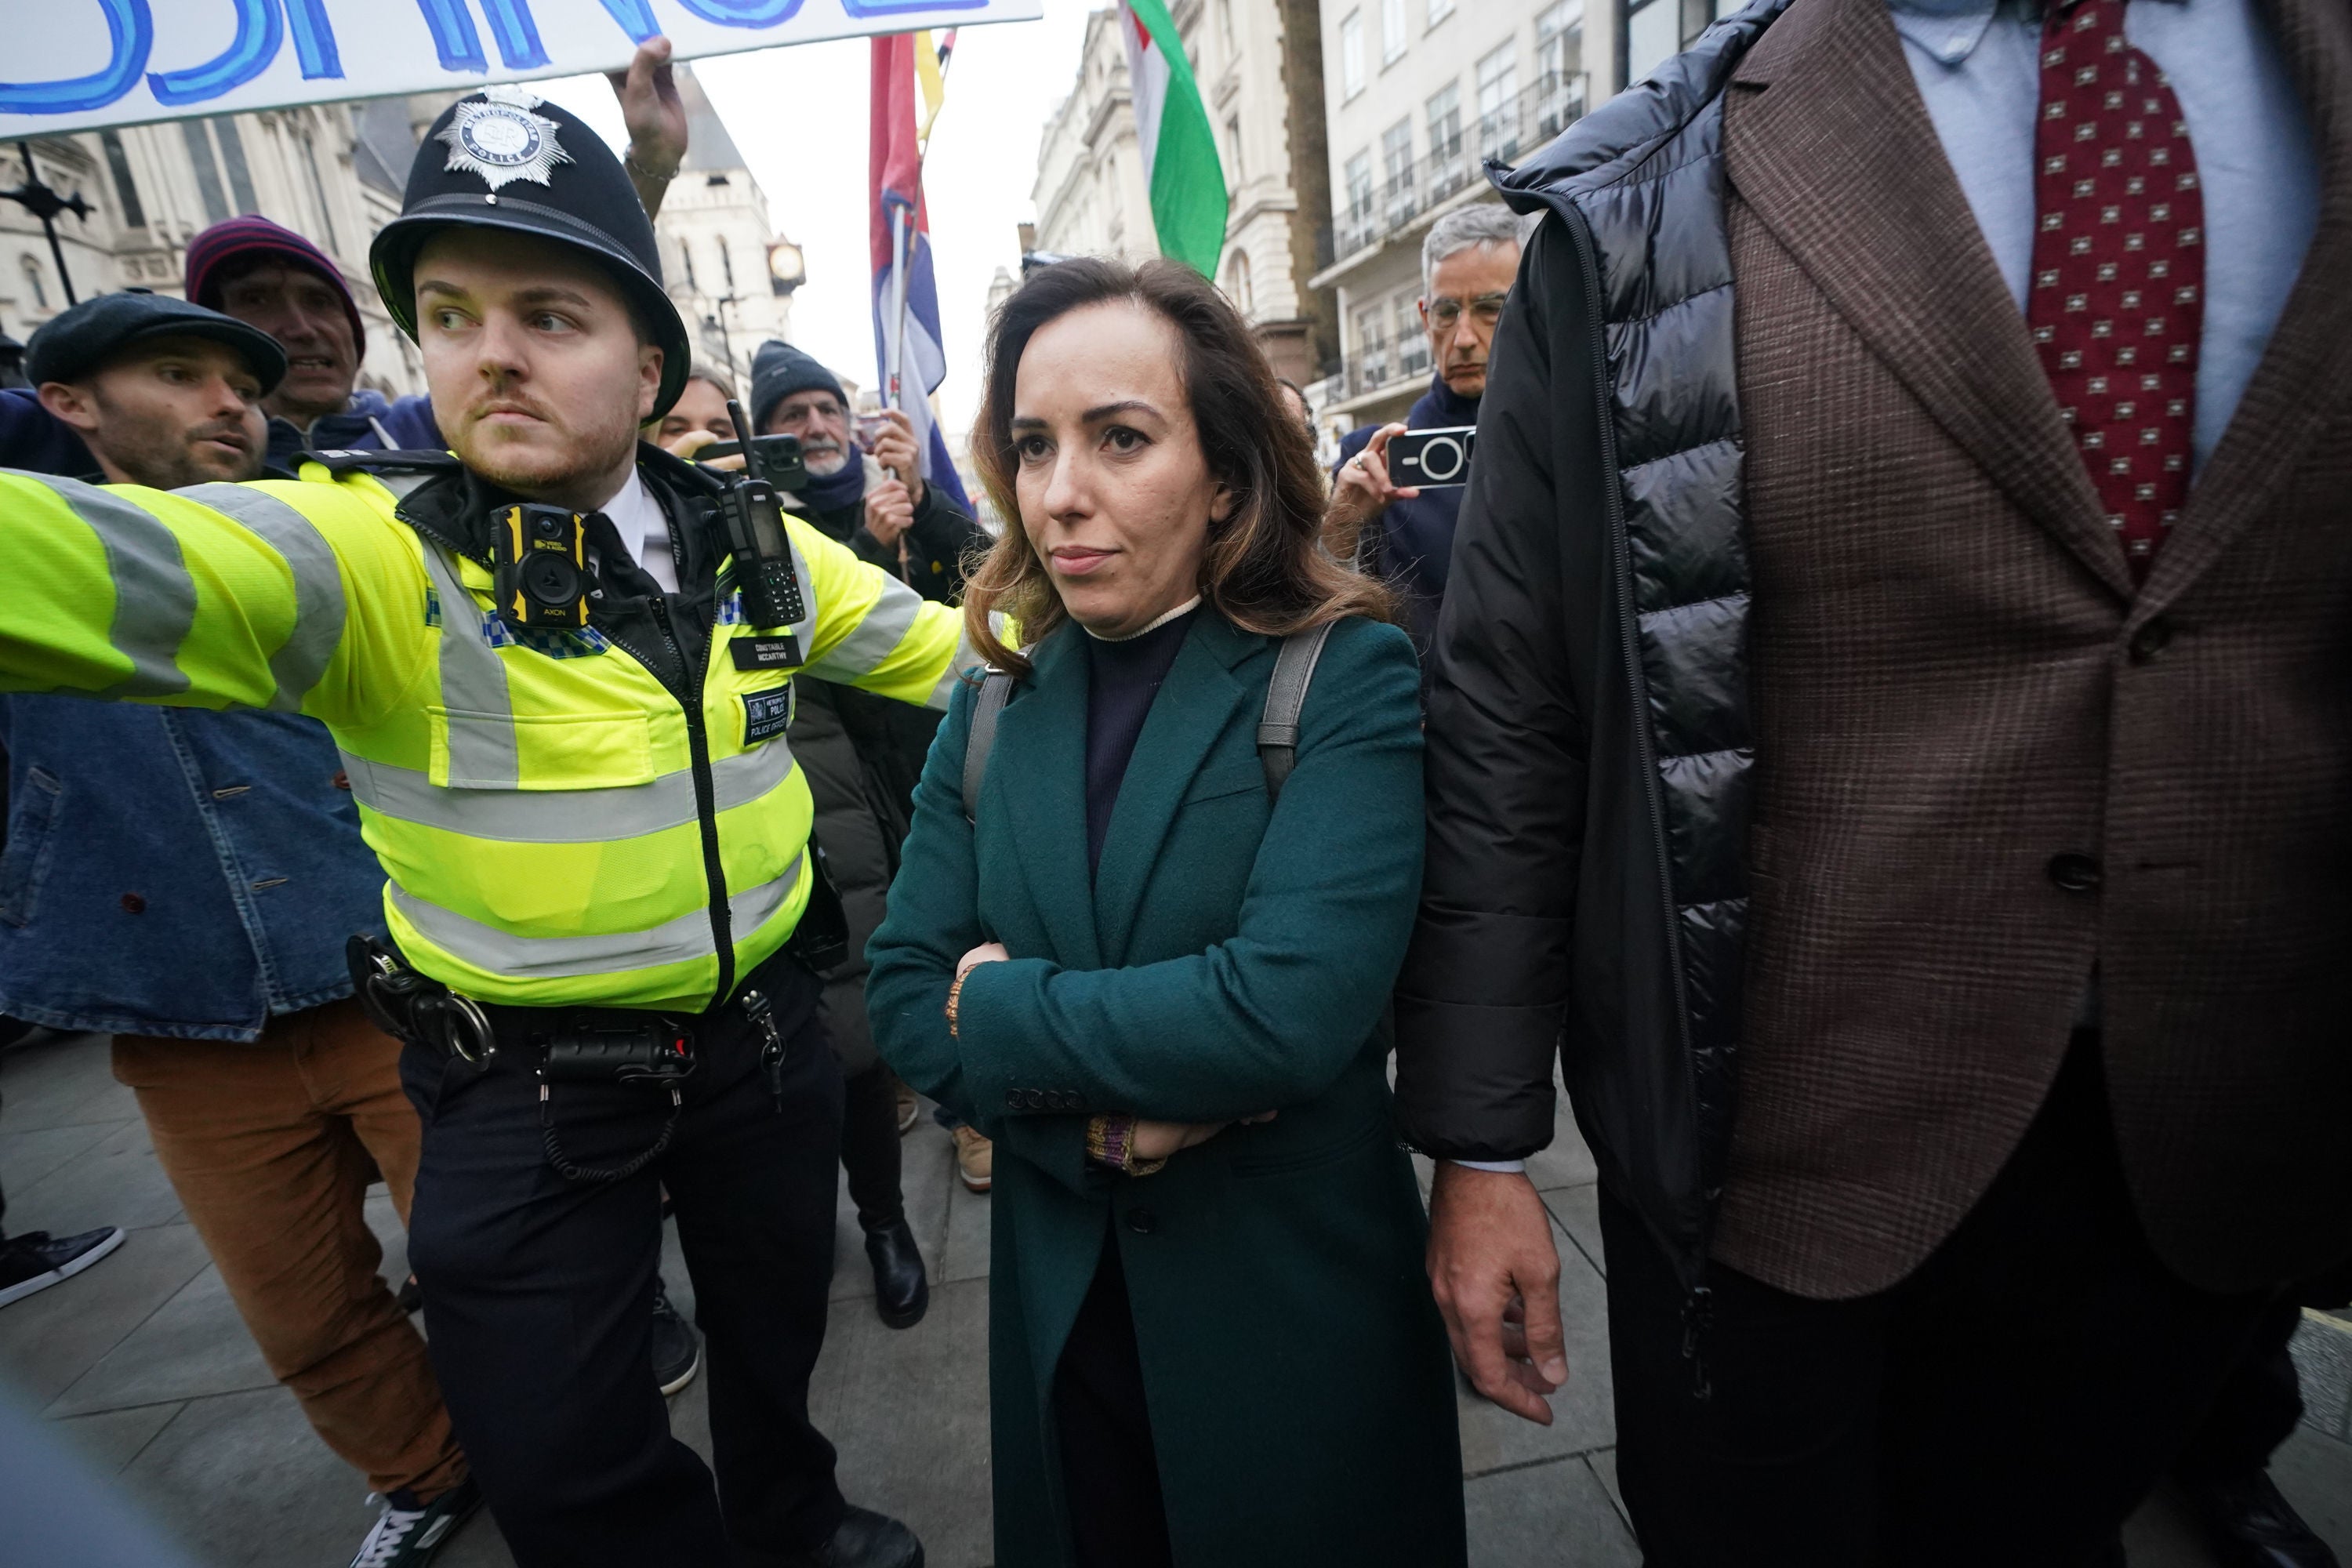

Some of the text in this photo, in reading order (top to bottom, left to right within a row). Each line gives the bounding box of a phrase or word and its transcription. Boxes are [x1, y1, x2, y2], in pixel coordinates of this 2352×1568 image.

[468, 143, 526, 162] POLICE
[755, 643, 785, 652] CONSTABLE
[770, 702, 785, 716] POLICE
[750, 723, 771, 738] POLICE
